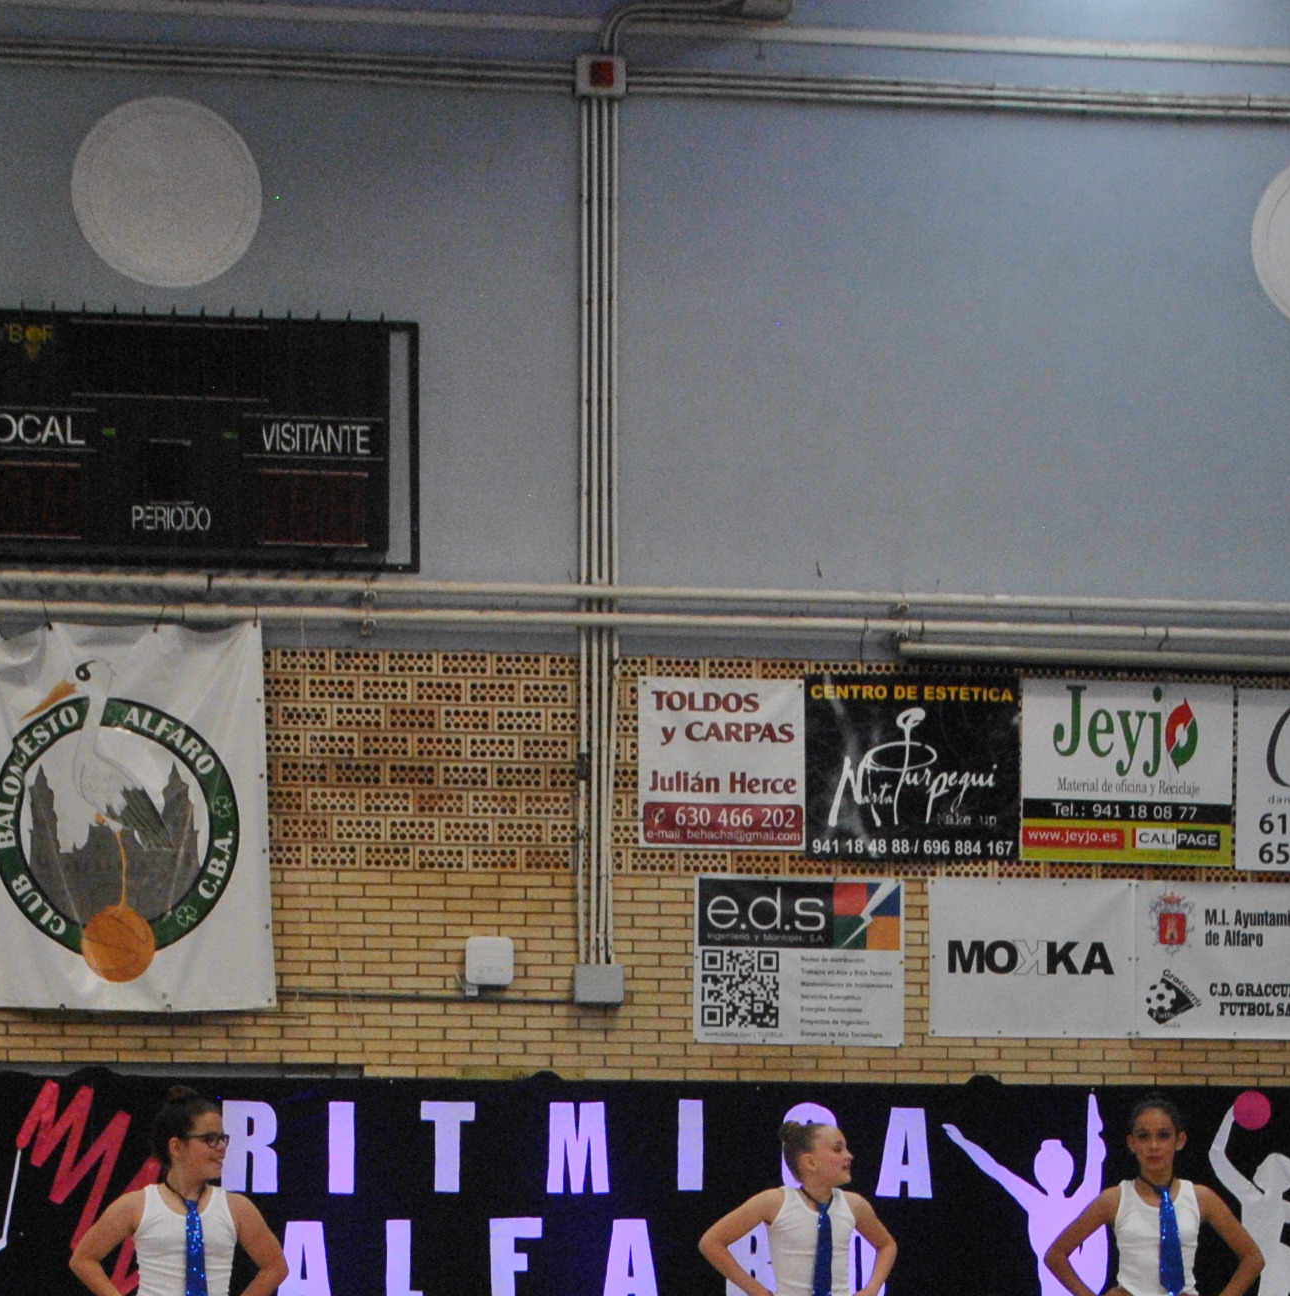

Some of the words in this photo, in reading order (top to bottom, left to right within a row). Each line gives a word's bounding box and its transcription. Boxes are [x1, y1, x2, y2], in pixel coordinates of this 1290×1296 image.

[261, 424, 371, 454] VISITANTE
[132, 505, 211, 531] PERIODO
[811, 685, 887, 699] CENTRO
[894, 685, 918, 700] DE
[651, 691, 760, 713] TOLDOS
[660, 726, 676, 746] y
[685, 722, 795, 743] CARPAS
[649, 770, 720, 793] Julián
[730, 772, 797, 794] Herce
[1058, 777, 1098, 792] Material
[1102, 779, 1112, 792] de
[1116, 780, 1147, 793] oficina
[1160, 781, 1200, 796] Reciclaje
[675, 807, 710, 826] 630
[718, 808, 753, 827] 466
[761, 808, 796, 828] 202
[1052, 803, 1085, 817] Tel.:
[1093, 804, 1120, 817] 941
[1129, 805, 1147, 818] 18
[1153, 806, 1172, 819] 08
[1179, 807, 1197, 819] 77
[11, 873, 66, 936] CLUB
[123, 707, 215, 776] ALFARO
[198, 829, 234, 899] C.B.A.
[1029, 829, 1117, 843] www.jeyjo.es
[1138, 833, 1218, 846] CALIPAGE
[813, 839, 839, 854] 941
[846, 839, 863, 853] 18
[868, 839, 886, 854] 48
[892, 840, 909, 854] 88
[923, 840, 950, 854] 696
[955, 840, 982, 855] 884
[987, 841, 1013, 855] 167
[707, 887, 826, 931] e.d.s
[1205, 909, 1229, 926] M.I.
[1205, 931, 1219, 946] de
[1224, 930, 1263, 947] Alfaro
[1210, 983, 1233, 996] C.D.
[1220, 1002, 1274, 1016] FUTBOL
